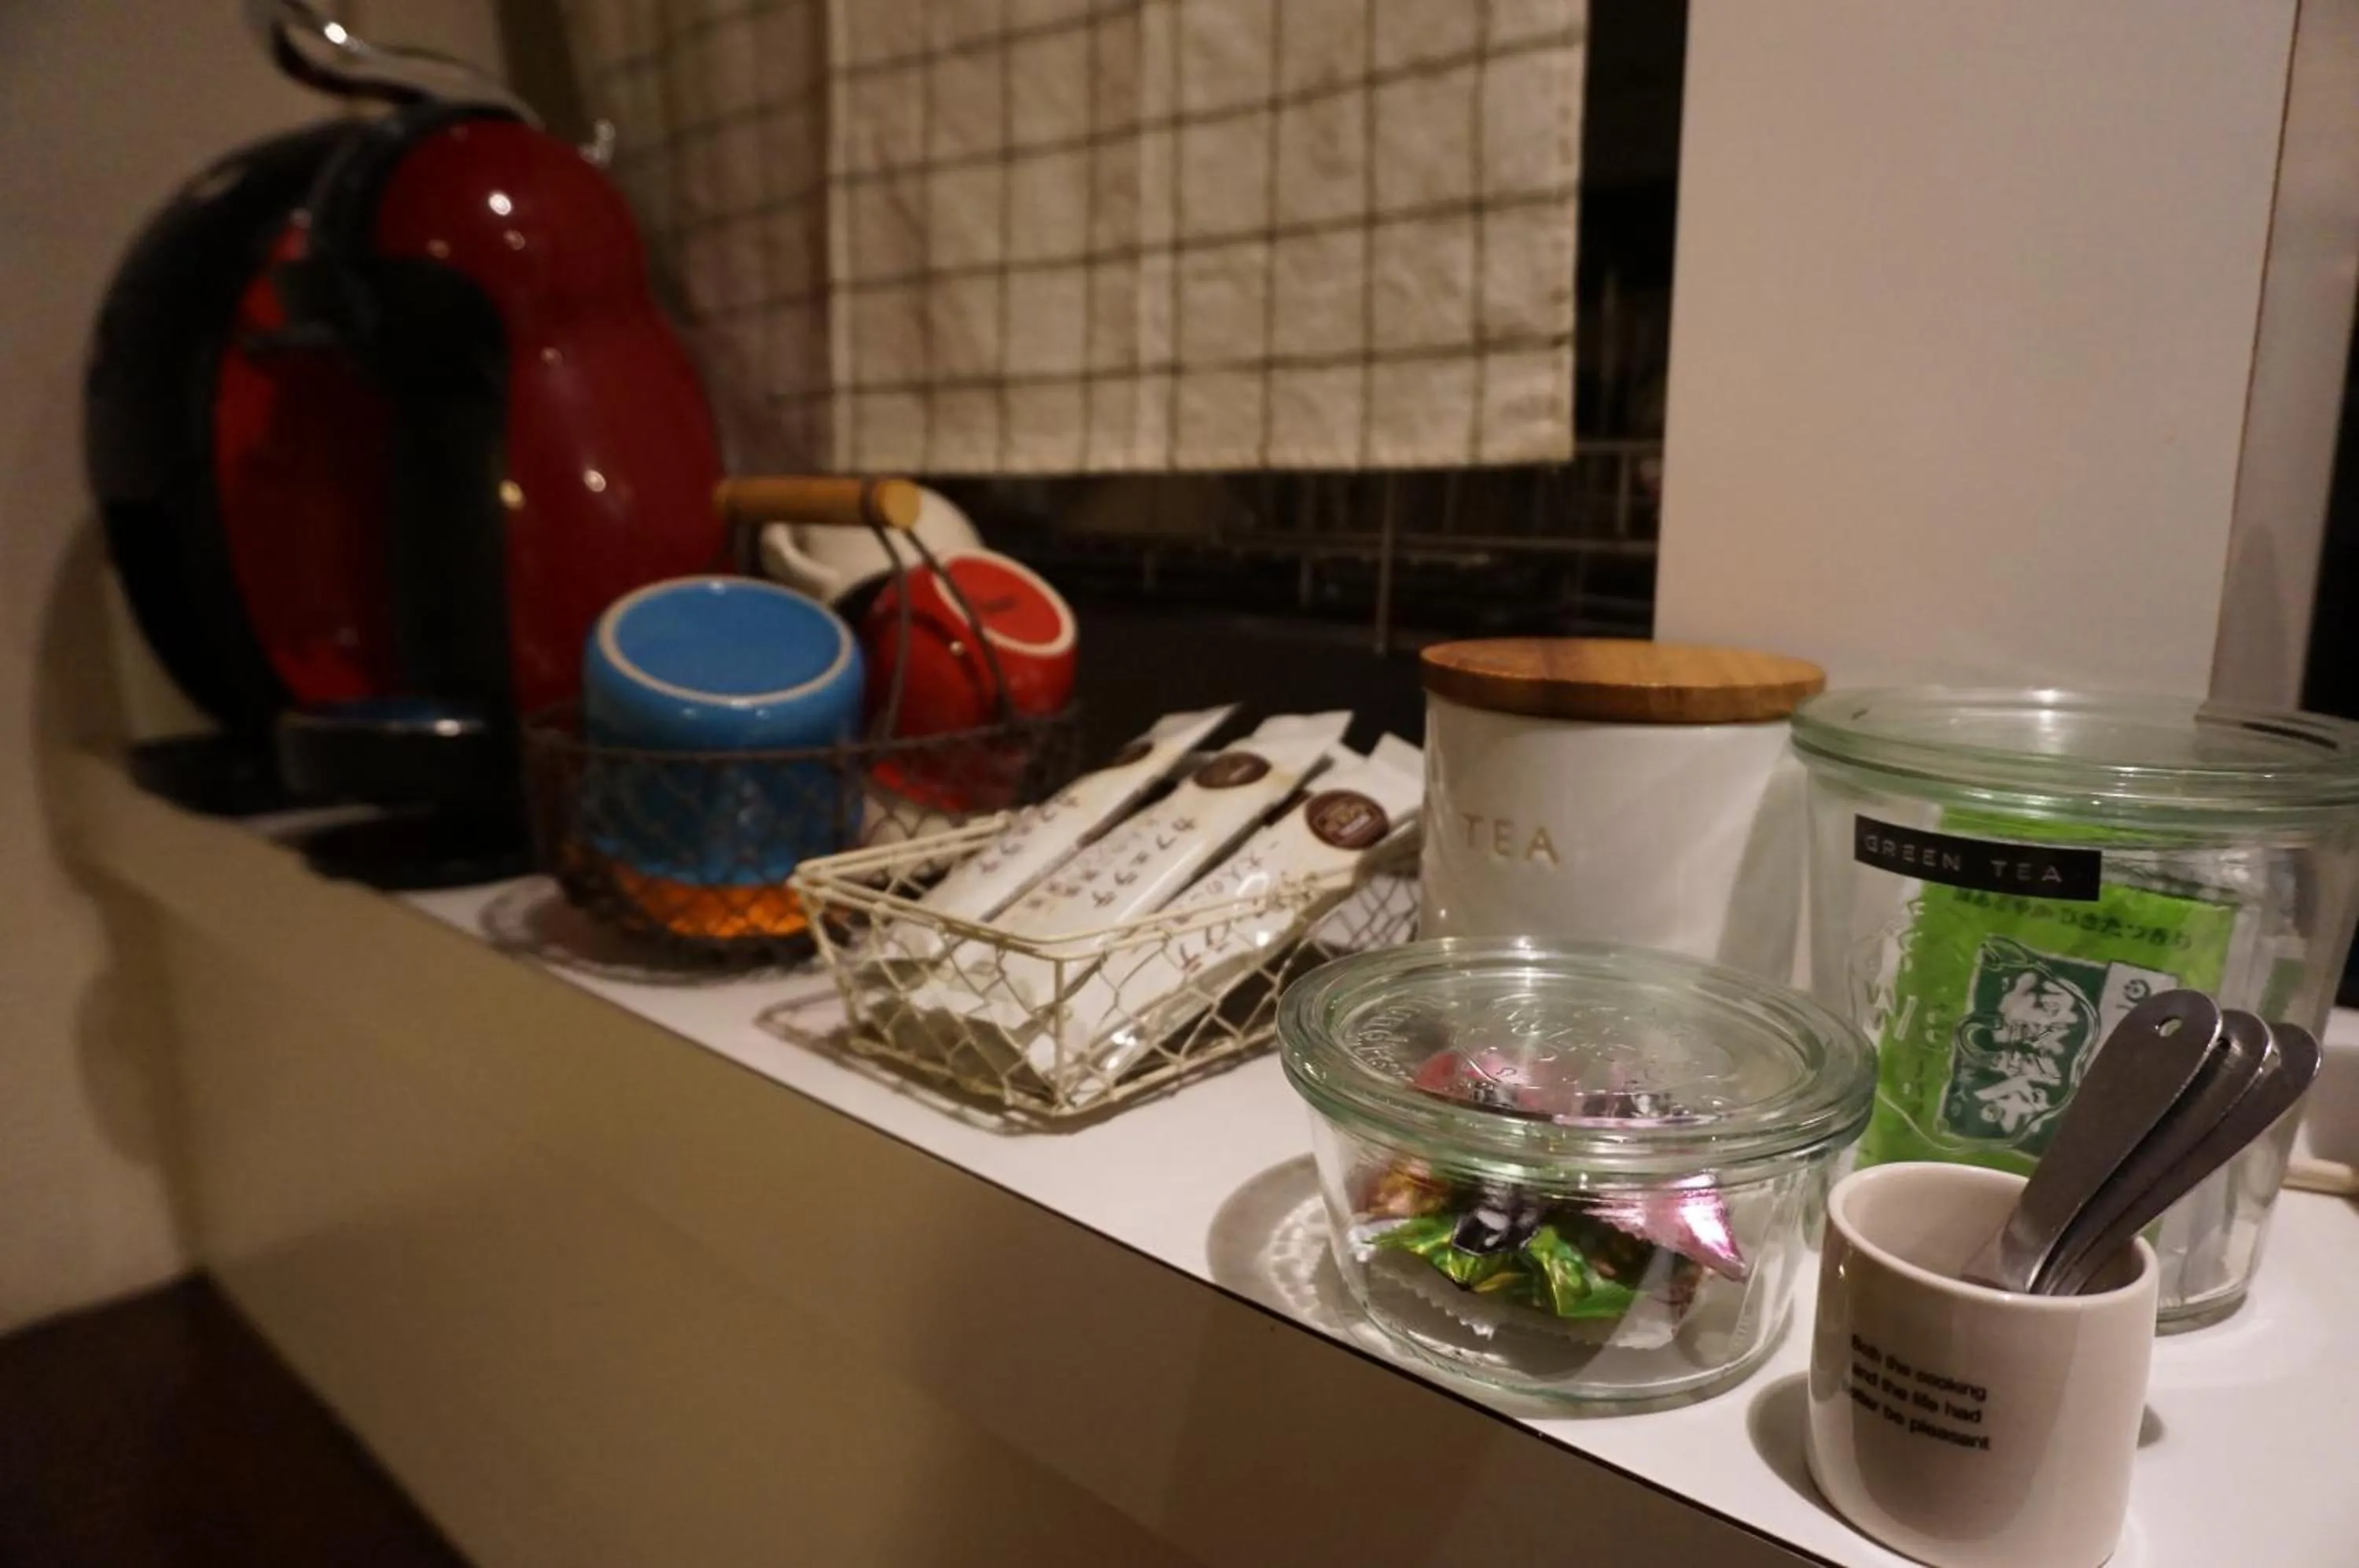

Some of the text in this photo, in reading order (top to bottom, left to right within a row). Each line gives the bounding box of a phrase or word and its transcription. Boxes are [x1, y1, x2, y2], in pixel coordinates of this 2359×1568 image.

[1461, 812, 1561, 866] TEA
[1862, 834, 2063, 884] GREEN TEA
[1851, 1362, 1983, 1424] and the life had
[1886, 1354, 1912, 1377] the
[1915, 1370, 1988, 1403] cooking
[1882, 1404, 1906, 1426] be
[1909, 1417, 1992, 1452] pleasant
